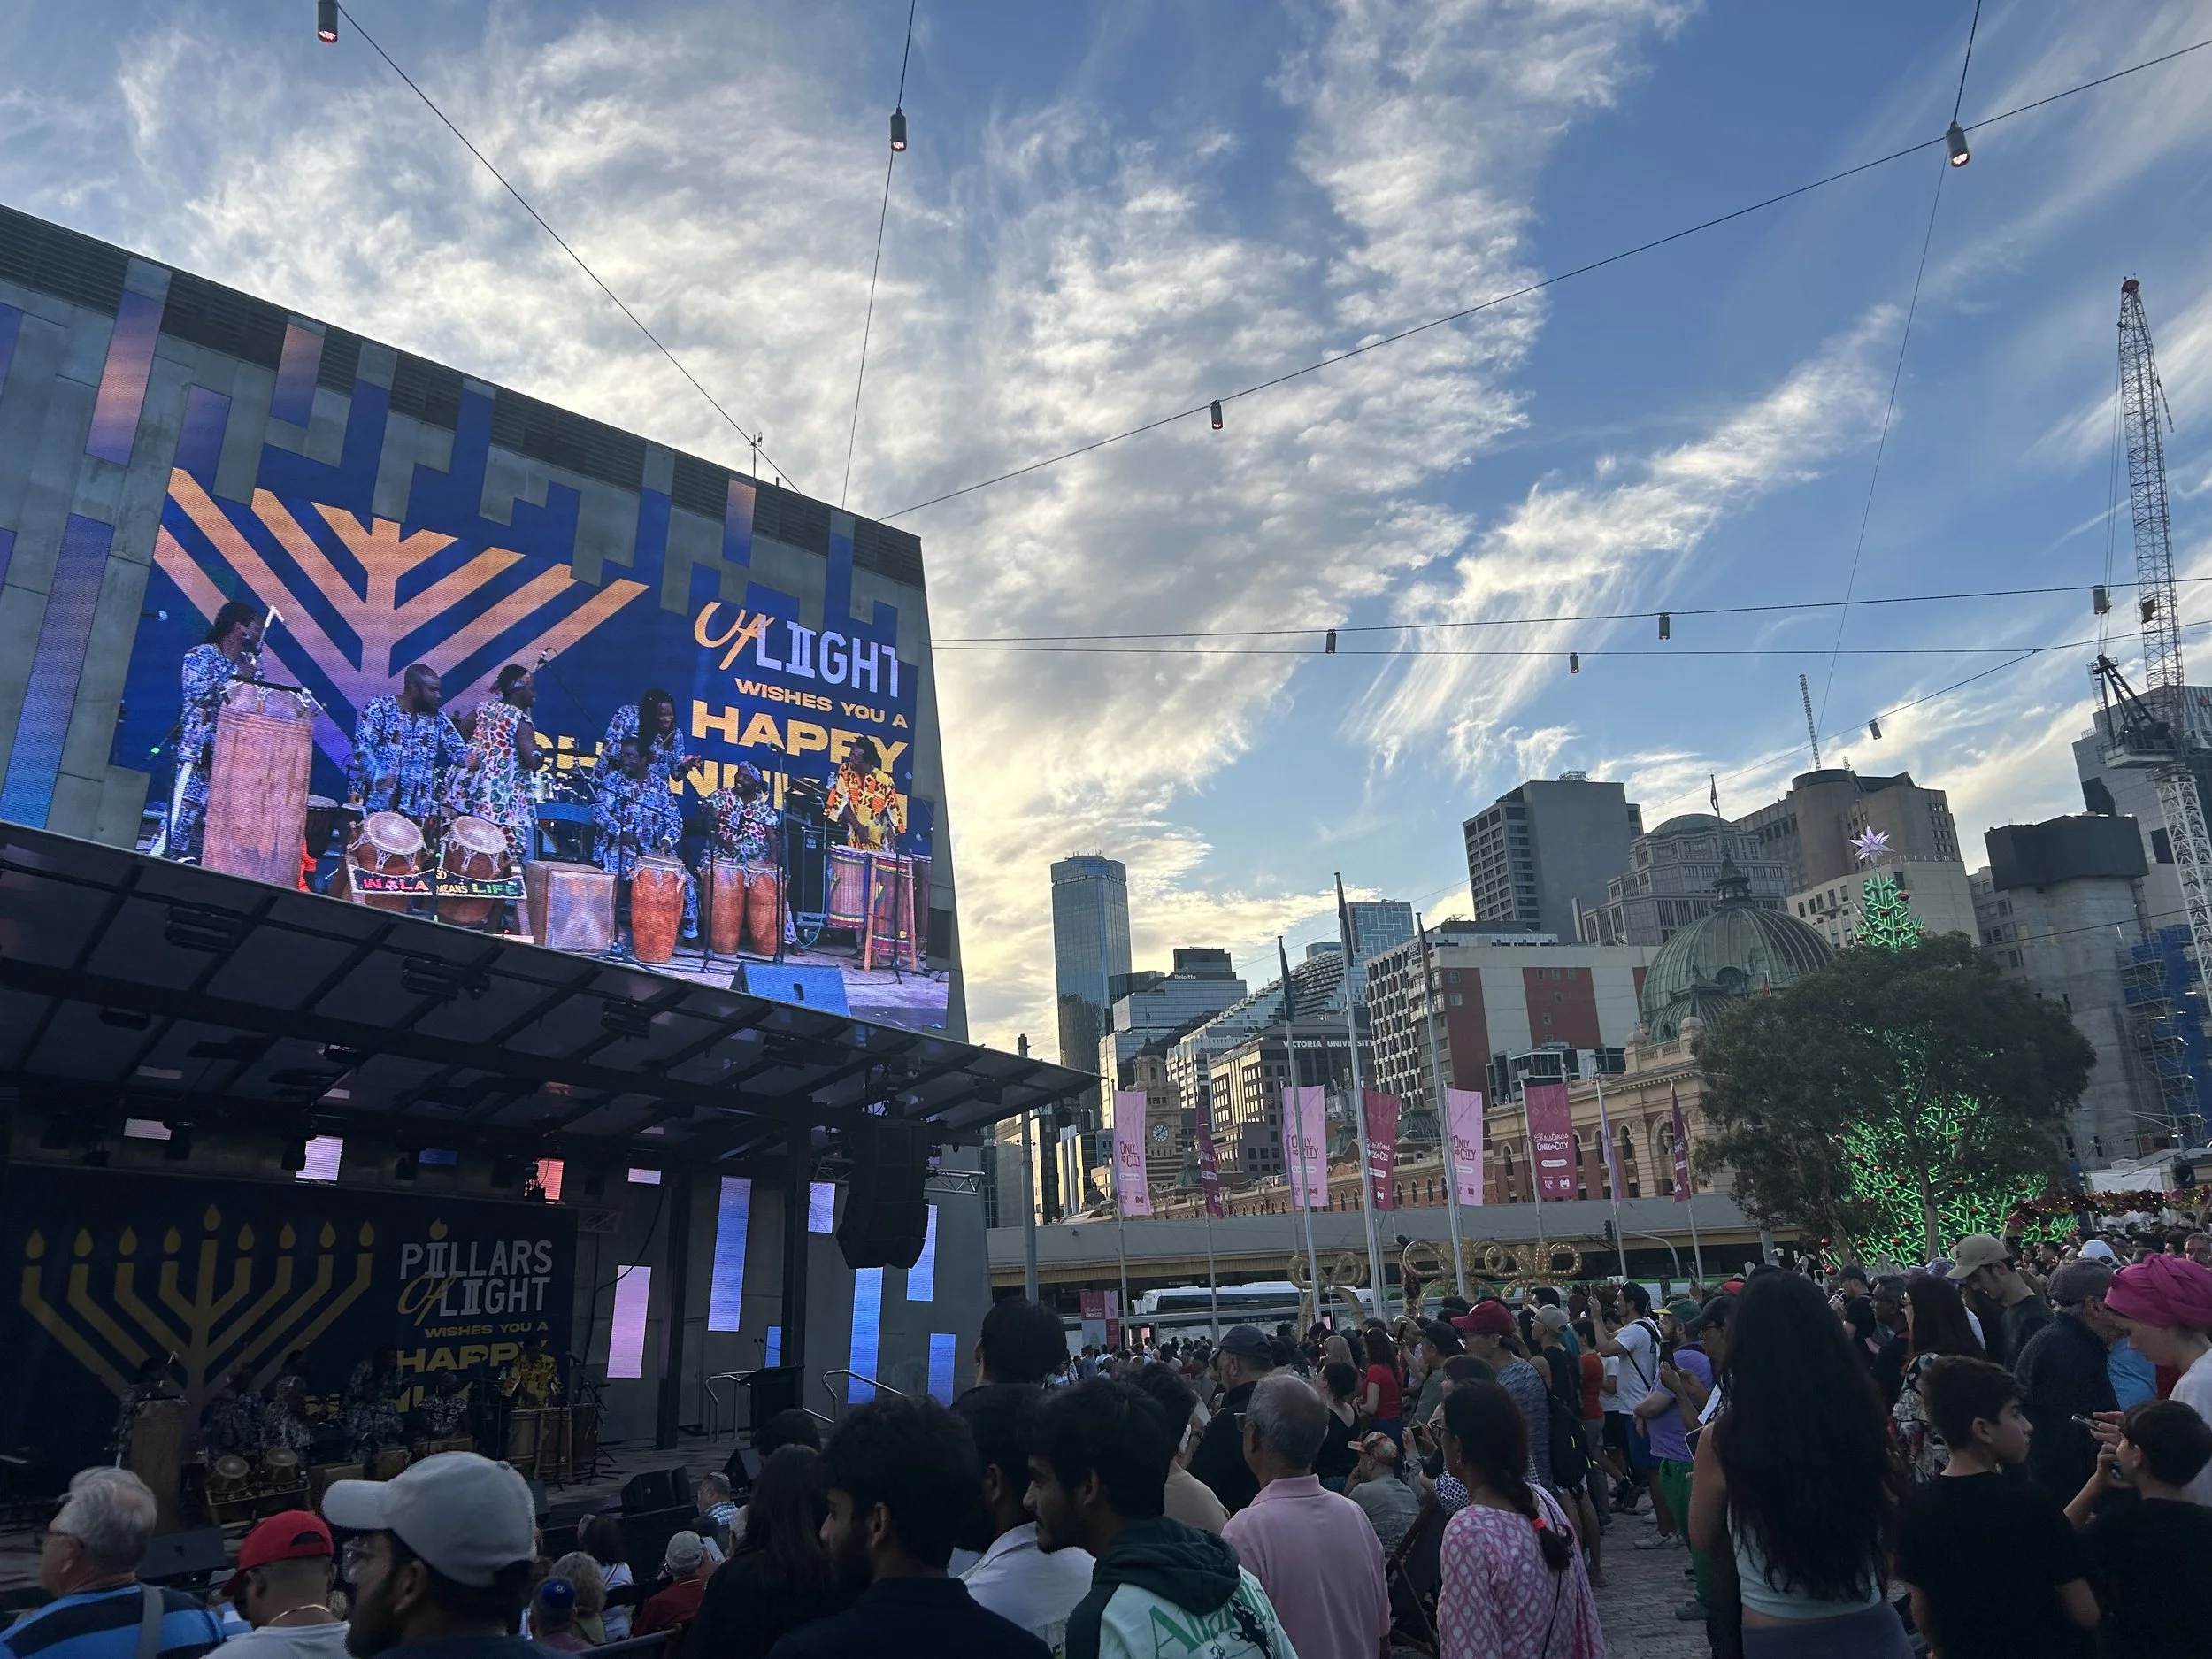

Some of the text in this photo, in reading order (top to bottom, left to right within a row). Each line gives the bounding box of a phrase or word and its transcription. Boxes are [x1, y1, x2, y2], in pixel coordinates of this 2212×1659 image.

[734, 677, 908, 728] WISHES YOU A
[691, 699, 908, 773] HAPPY
[363, 878, 429, 892] WALA
[472, 881, 518, 895] LIFE
[400, 1240, 553, 1279] PILLARS
[439, 1277, 550, 1317] LIGHT
[425, 1321, 549, 1338] WISHES YOU A
[397, 1340, 549, 1373] HAPP
